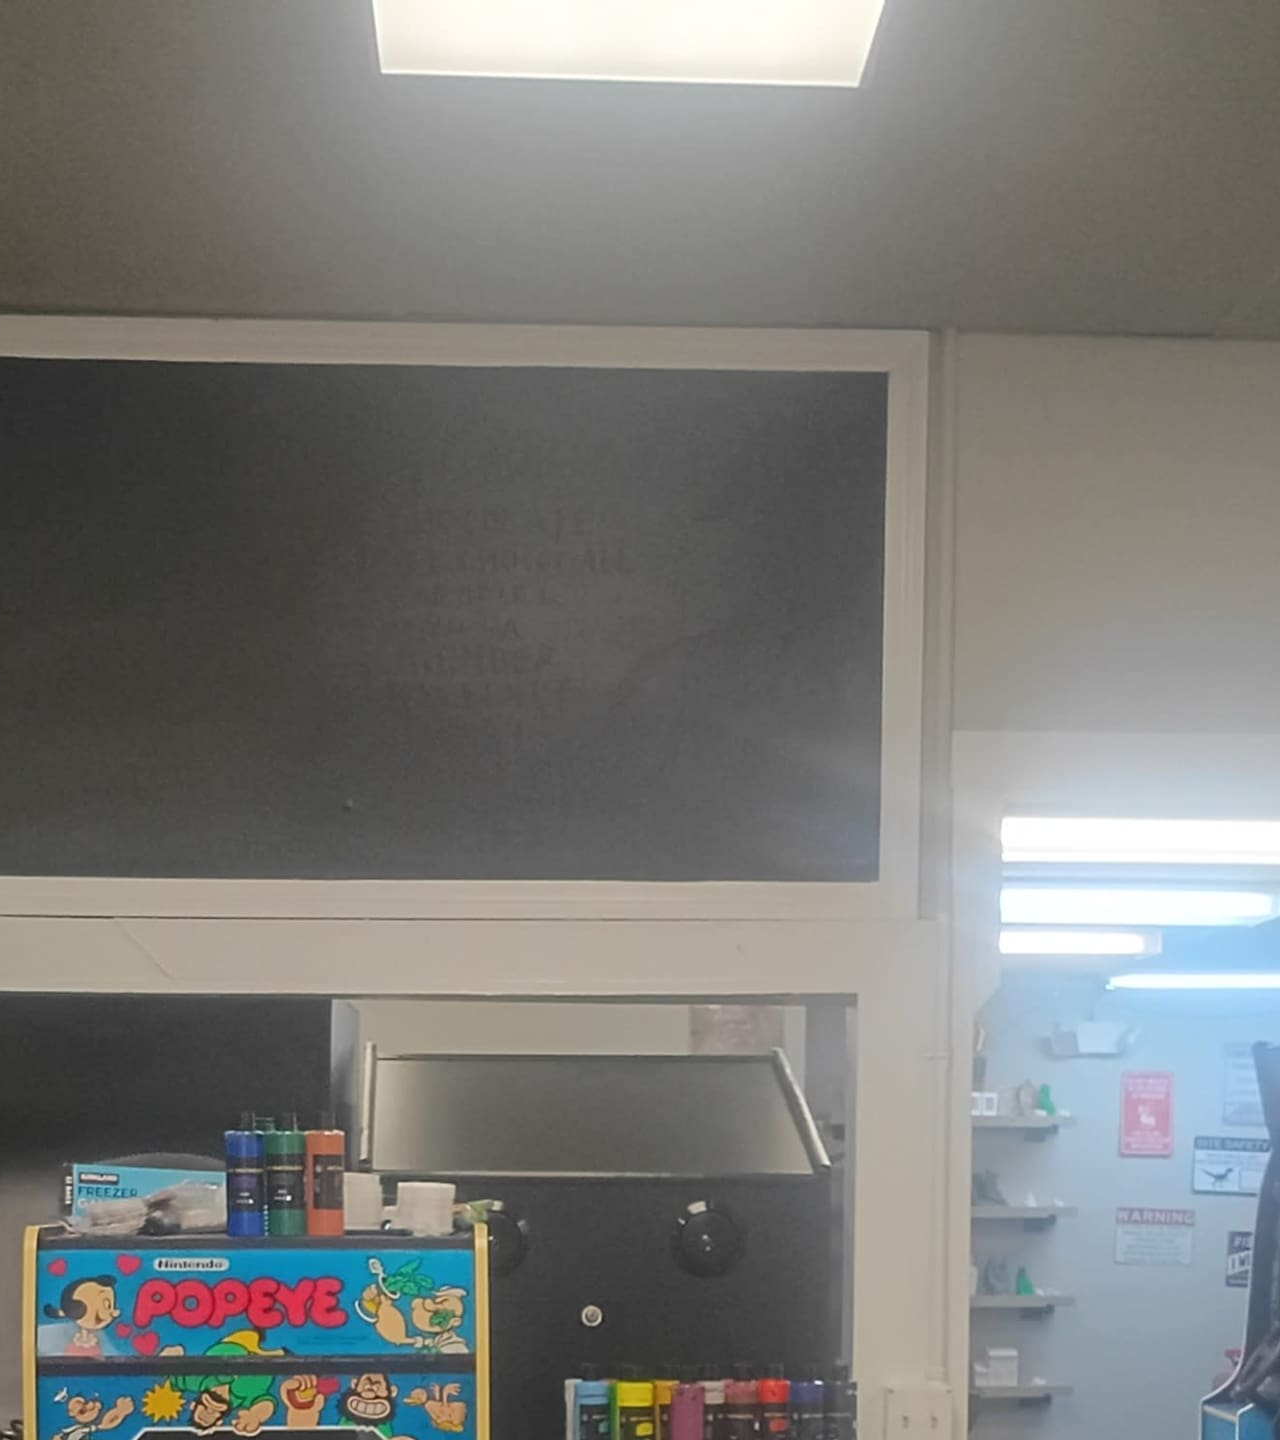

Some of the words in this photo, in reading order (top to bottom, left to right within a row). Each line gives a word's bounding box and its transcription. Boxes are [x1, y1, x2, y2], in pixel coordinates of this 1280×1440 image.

[78, 1186, 138, 1198] FREEZER
[1117, 1210, 1194, 1224] WARNING
[157, 1259, 225, 1270] Nintendo
[134, 1276, 348, 1328] POPEYE
